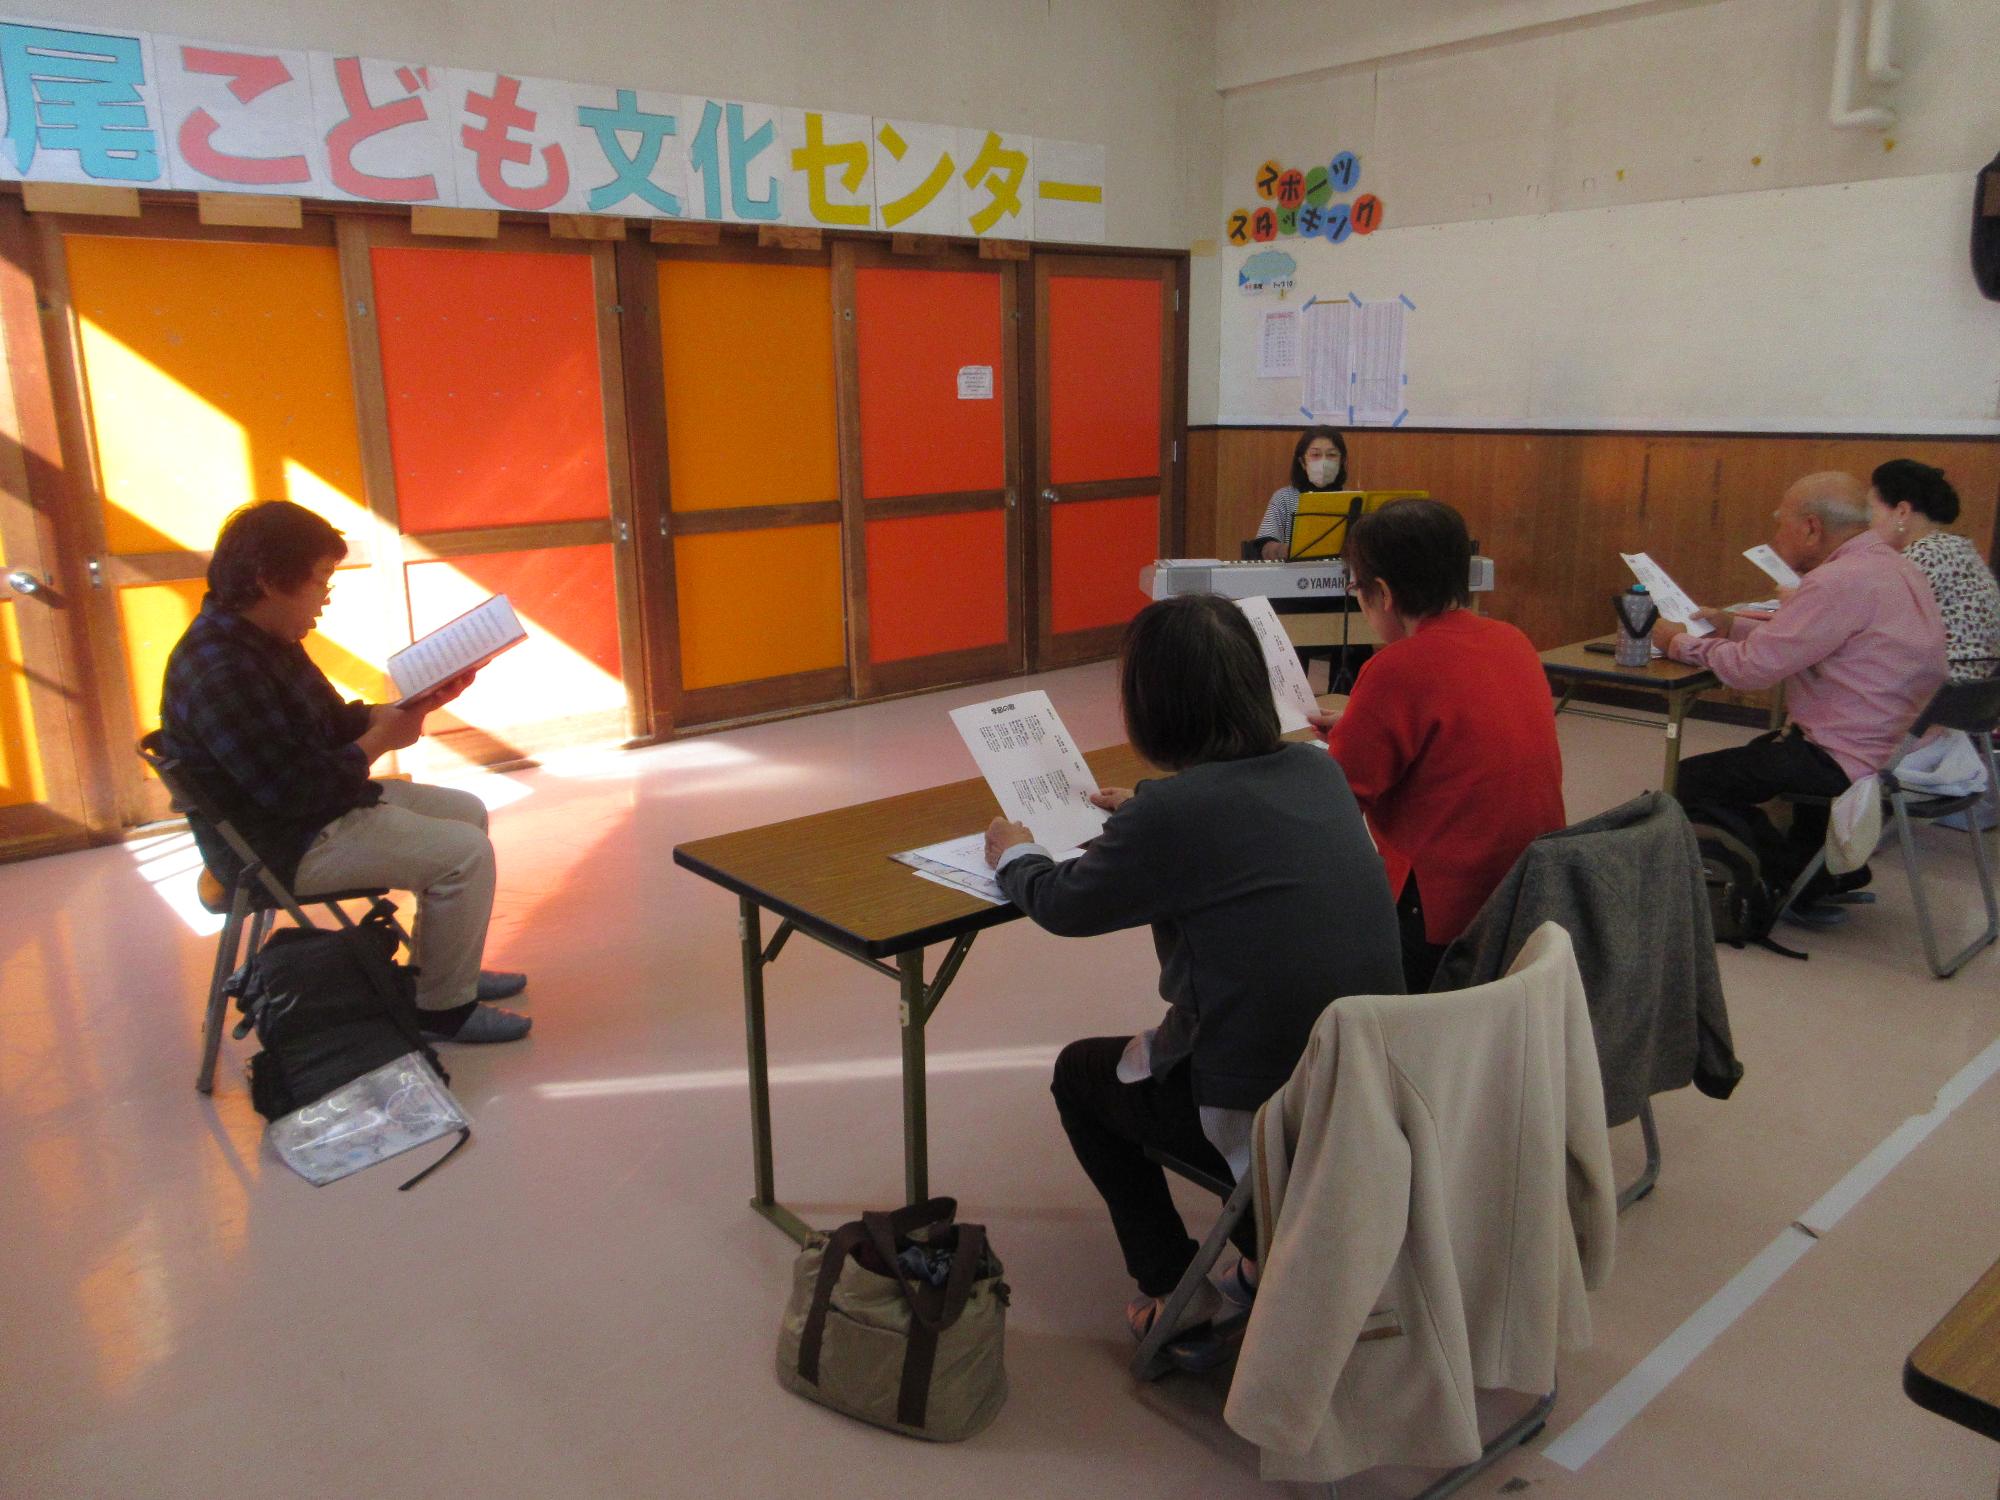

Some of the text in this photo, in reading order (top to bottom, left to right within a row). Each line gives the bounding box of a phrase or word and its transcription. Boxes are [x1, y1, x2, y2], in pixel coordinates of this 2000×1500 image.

[0, 22, 1102, 236] 尾こども文化センター
[1310, 577, 1345, 589] YAMAH
